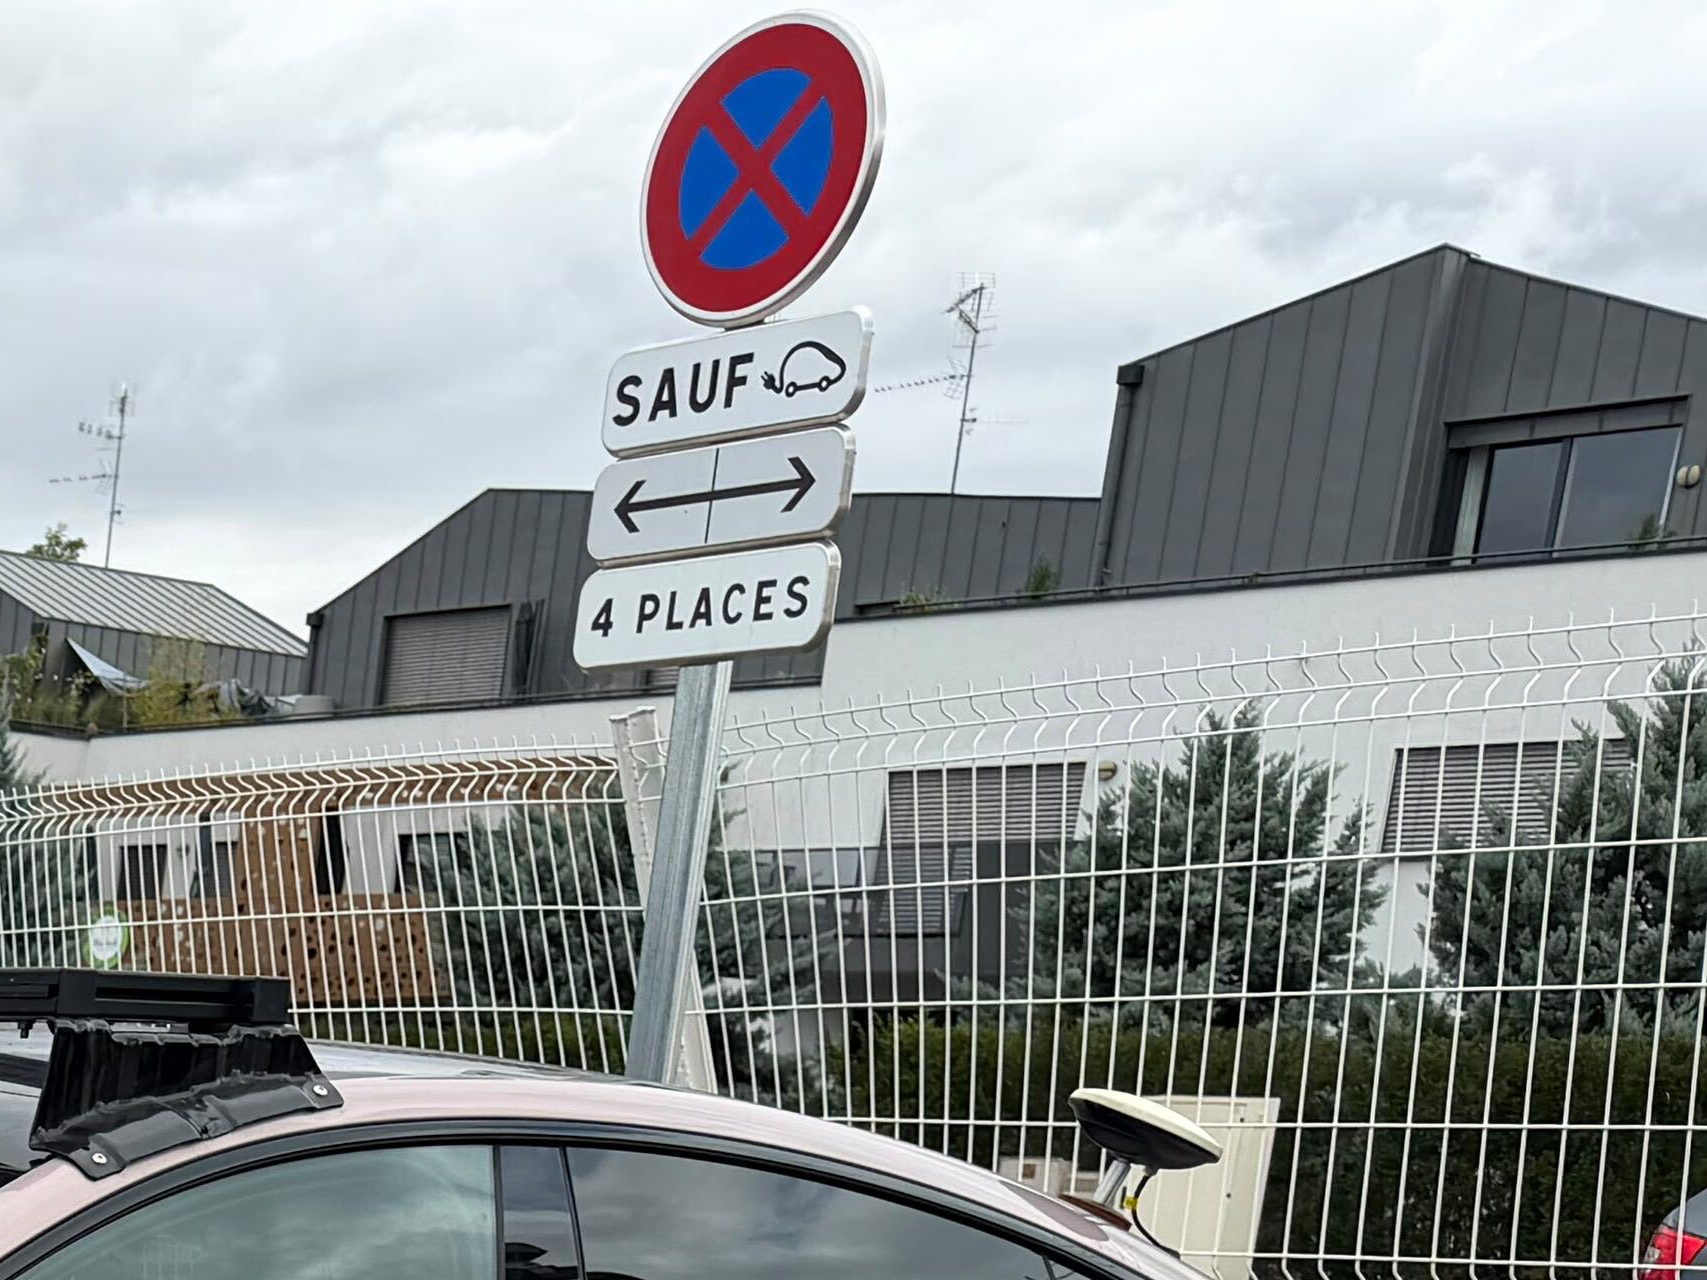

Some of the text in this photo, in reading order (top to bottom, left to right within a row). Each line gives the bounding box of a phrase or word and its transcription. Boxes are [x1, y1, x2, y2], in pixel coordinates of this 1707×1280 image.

[612, 352, 755, 427] SAUF
[590, 575, 810, 638] 4 PLACES
